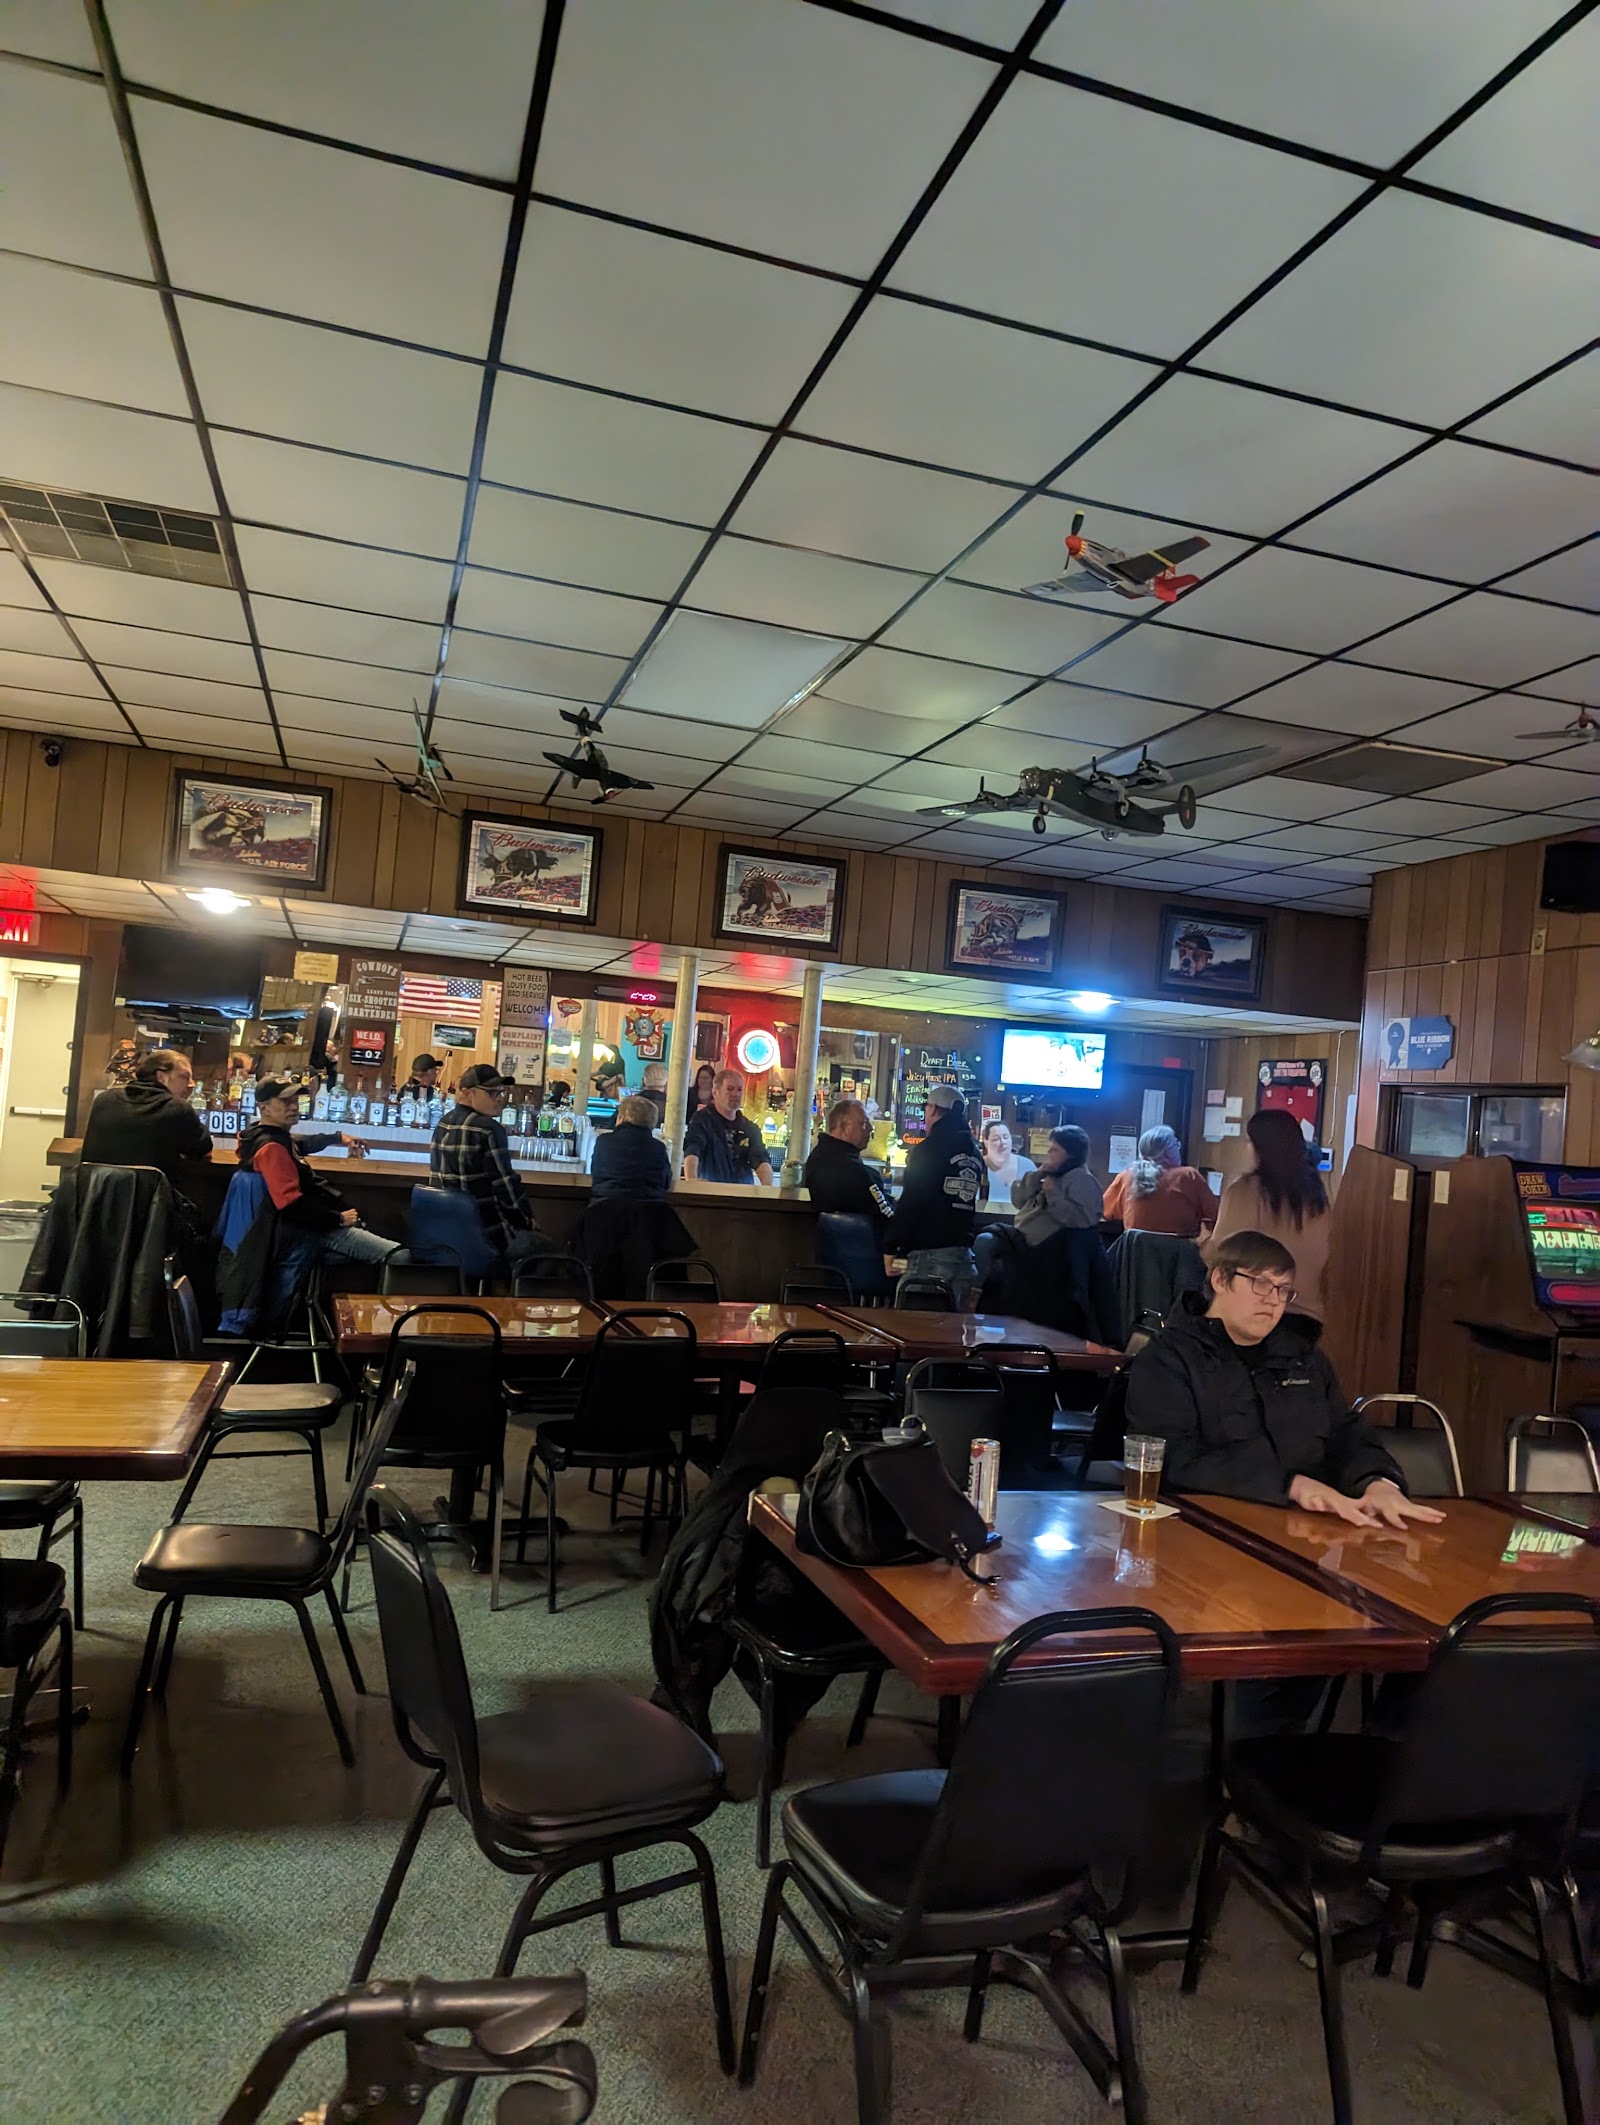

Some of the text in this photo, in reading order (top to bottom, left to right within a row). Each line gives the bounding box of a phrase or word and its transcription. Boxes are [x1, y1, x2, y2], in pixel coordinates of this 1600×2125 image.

[201, 791, 304, 815] Budweiser
[489, 832, 578, 855] Budweiser
[280, 861, 308, 871] FORCE
[742, 864, 822, 887] Budweiser
[973, 900, 1046, 918] Budweiser
[0, 912, 34, 942] XIT
[356, 961, 398, 977] COWBOYS
[527, 975, 543, 983] BEER
[507, 981, 527, 990] LOUSY
[507, 989, 546, 1000] BAD SERVICE
[347, 1007, 397, 1020] BARTENDER
[505, 1002, 546, 1016] WELCOME
[356, 1030, 368, 1039] WE
[502, 1031, 543, 1041] COMPLAINT
[1410, 1035, 1450, 1044] BLUE RIBBON
[501, 1039, 543, 1049] DEPARTMENT
[943, 1073, 956, 1083] IPA
[211, 1115, 236, 1130] 03
[1519, 1175, 1544, 1186] DRAW
[1519, 1185, 1548, 1196] POKER
